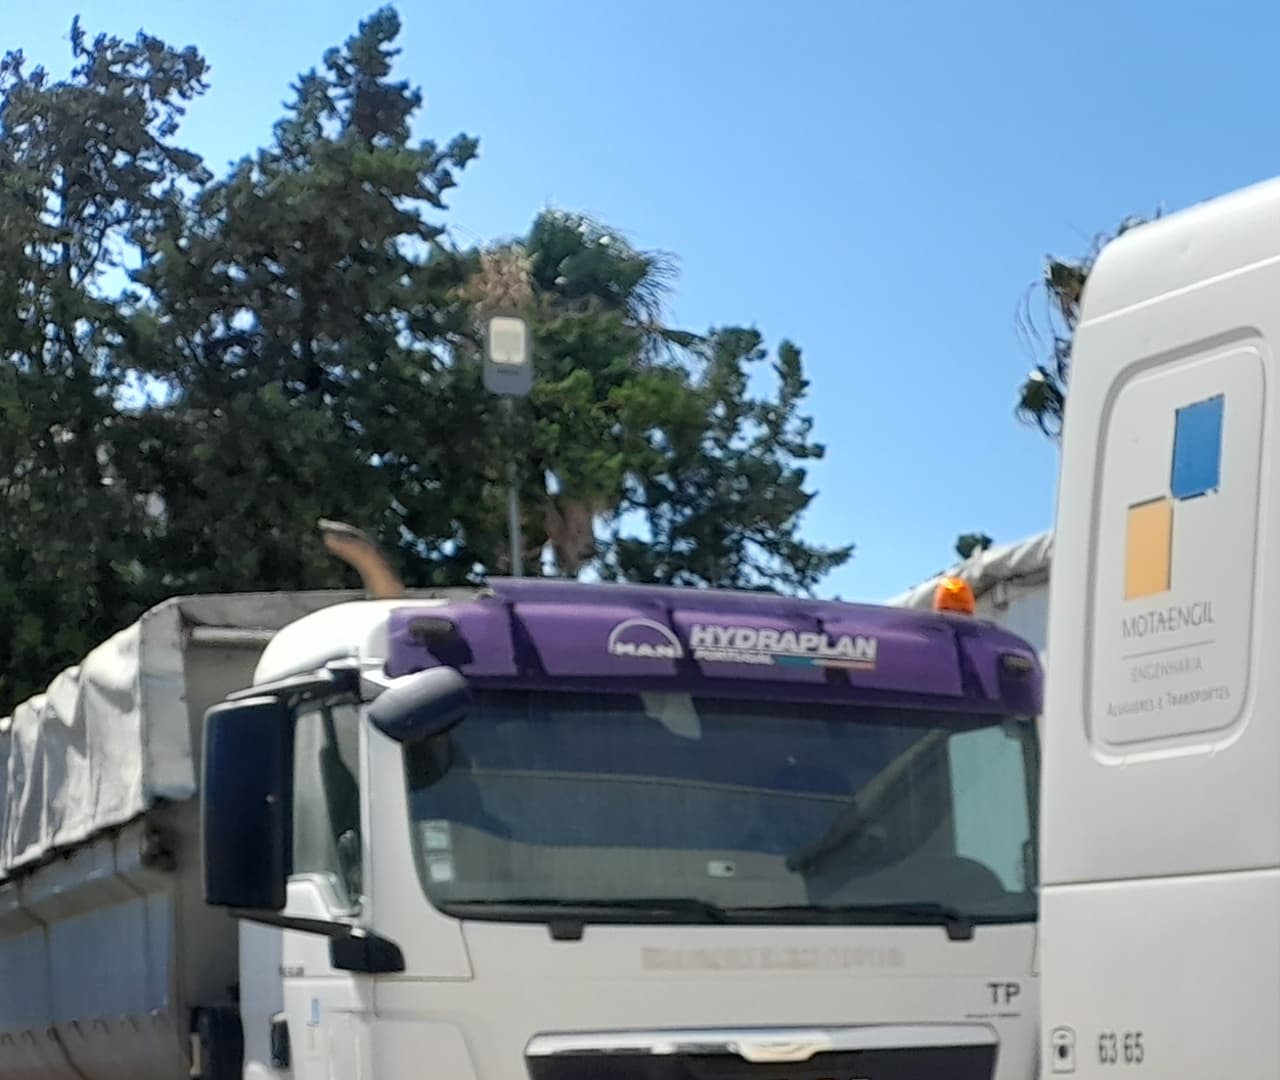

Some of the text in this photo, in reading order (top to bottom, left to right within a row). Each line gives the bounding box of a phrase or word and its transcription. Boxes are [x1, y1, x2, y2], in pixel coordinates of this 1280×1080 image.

[615, 642, 676, 656] MAN
[690, 624, 877, 658] HYDRAPLAN
[987, 981, 1021, 1005] TP
[1099, 1032, 1145, 1065] 63 65
